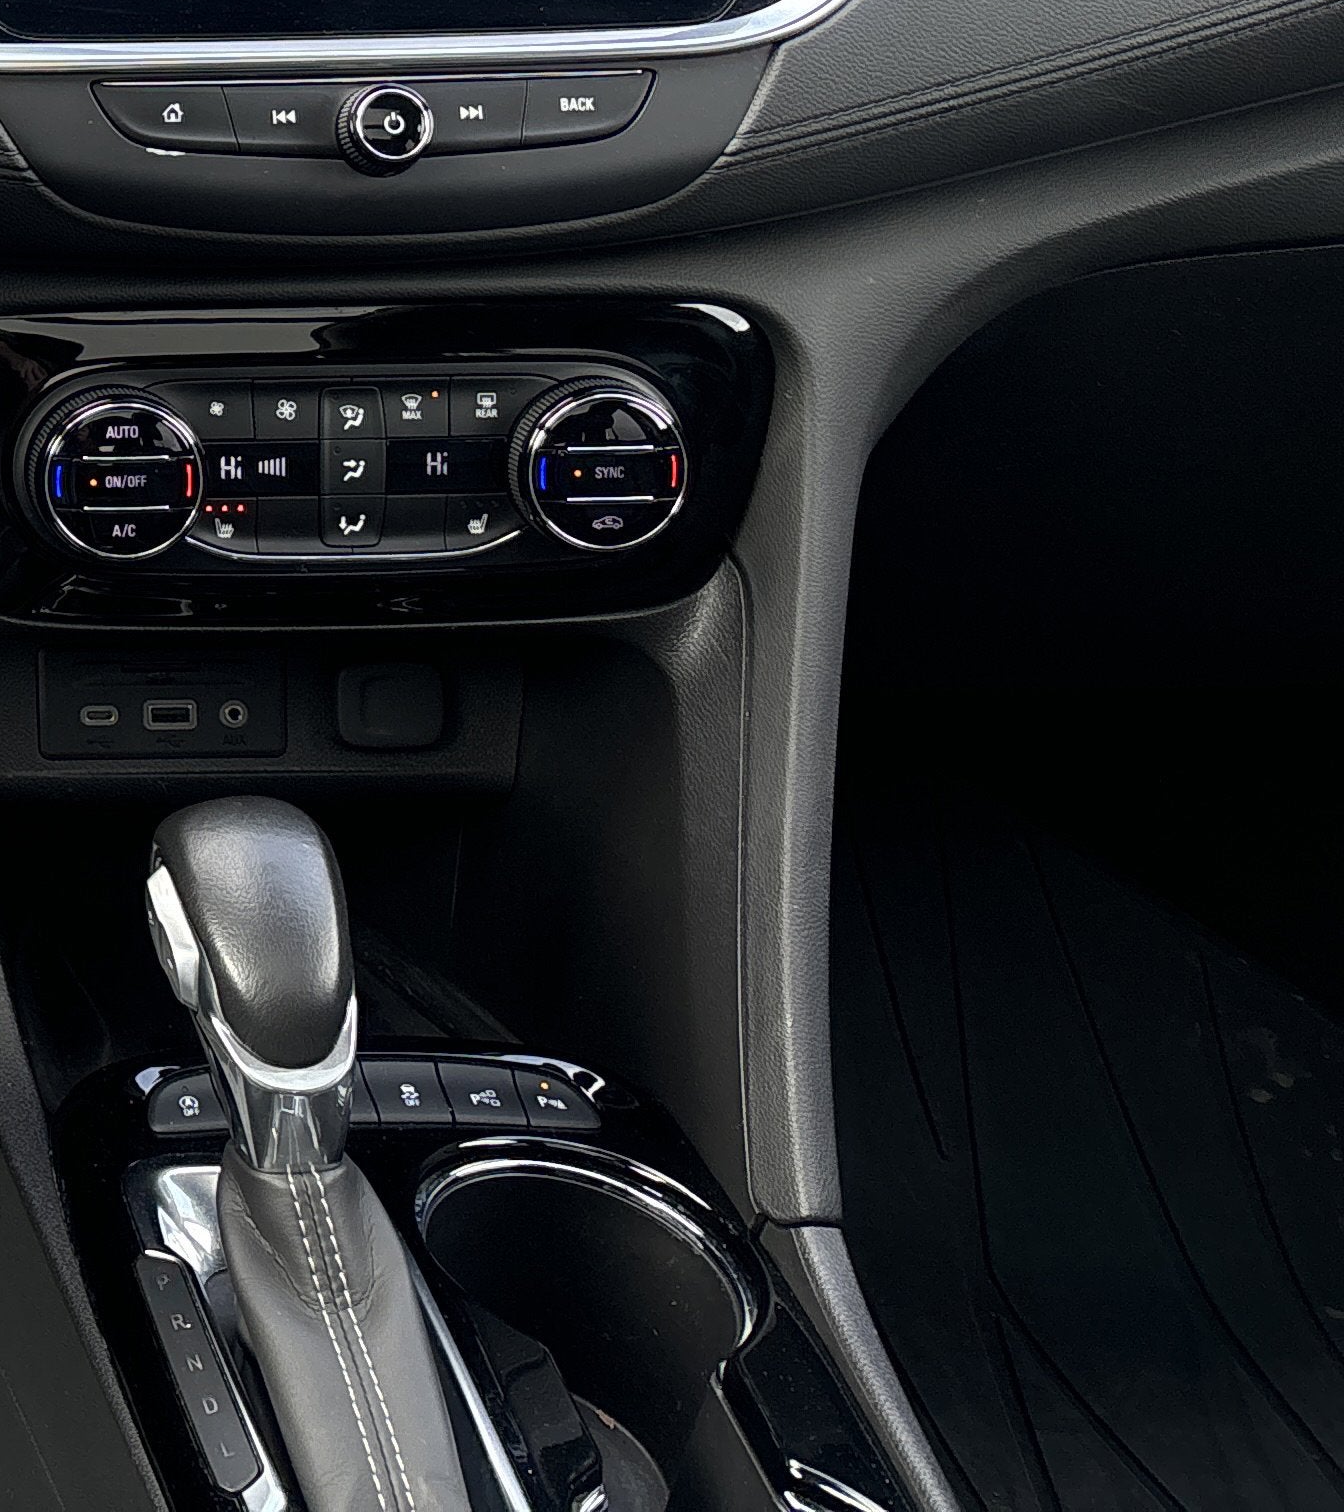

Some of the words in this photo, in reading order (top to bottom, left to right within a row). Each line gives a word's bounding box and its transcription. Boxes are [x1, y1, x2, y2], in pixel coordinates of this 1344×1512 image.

[559, 96, 595, 113] BACK
[402, 409, 423, 421] MAX
[475, 408, 499, 419] REAR
[105, 425, 140, 440] AUTO
[594, 465, 626, 480] SYNC
[104, 473, 148, 489] ON/OFF
[112, 523, 137, 539] A/C
[222, 734, 247, 746] AUX
[405, 1097, 422, 1107] OFF
[183, 1107, 201, 1117] OFF
[156, 1273, 171, 1291] P
[171, 1313, 189, 1331] R
[185, 1353, 205, 1372] N
[201, 1396, 219, 1416] D
[220, 1441, 236, 1458] L
